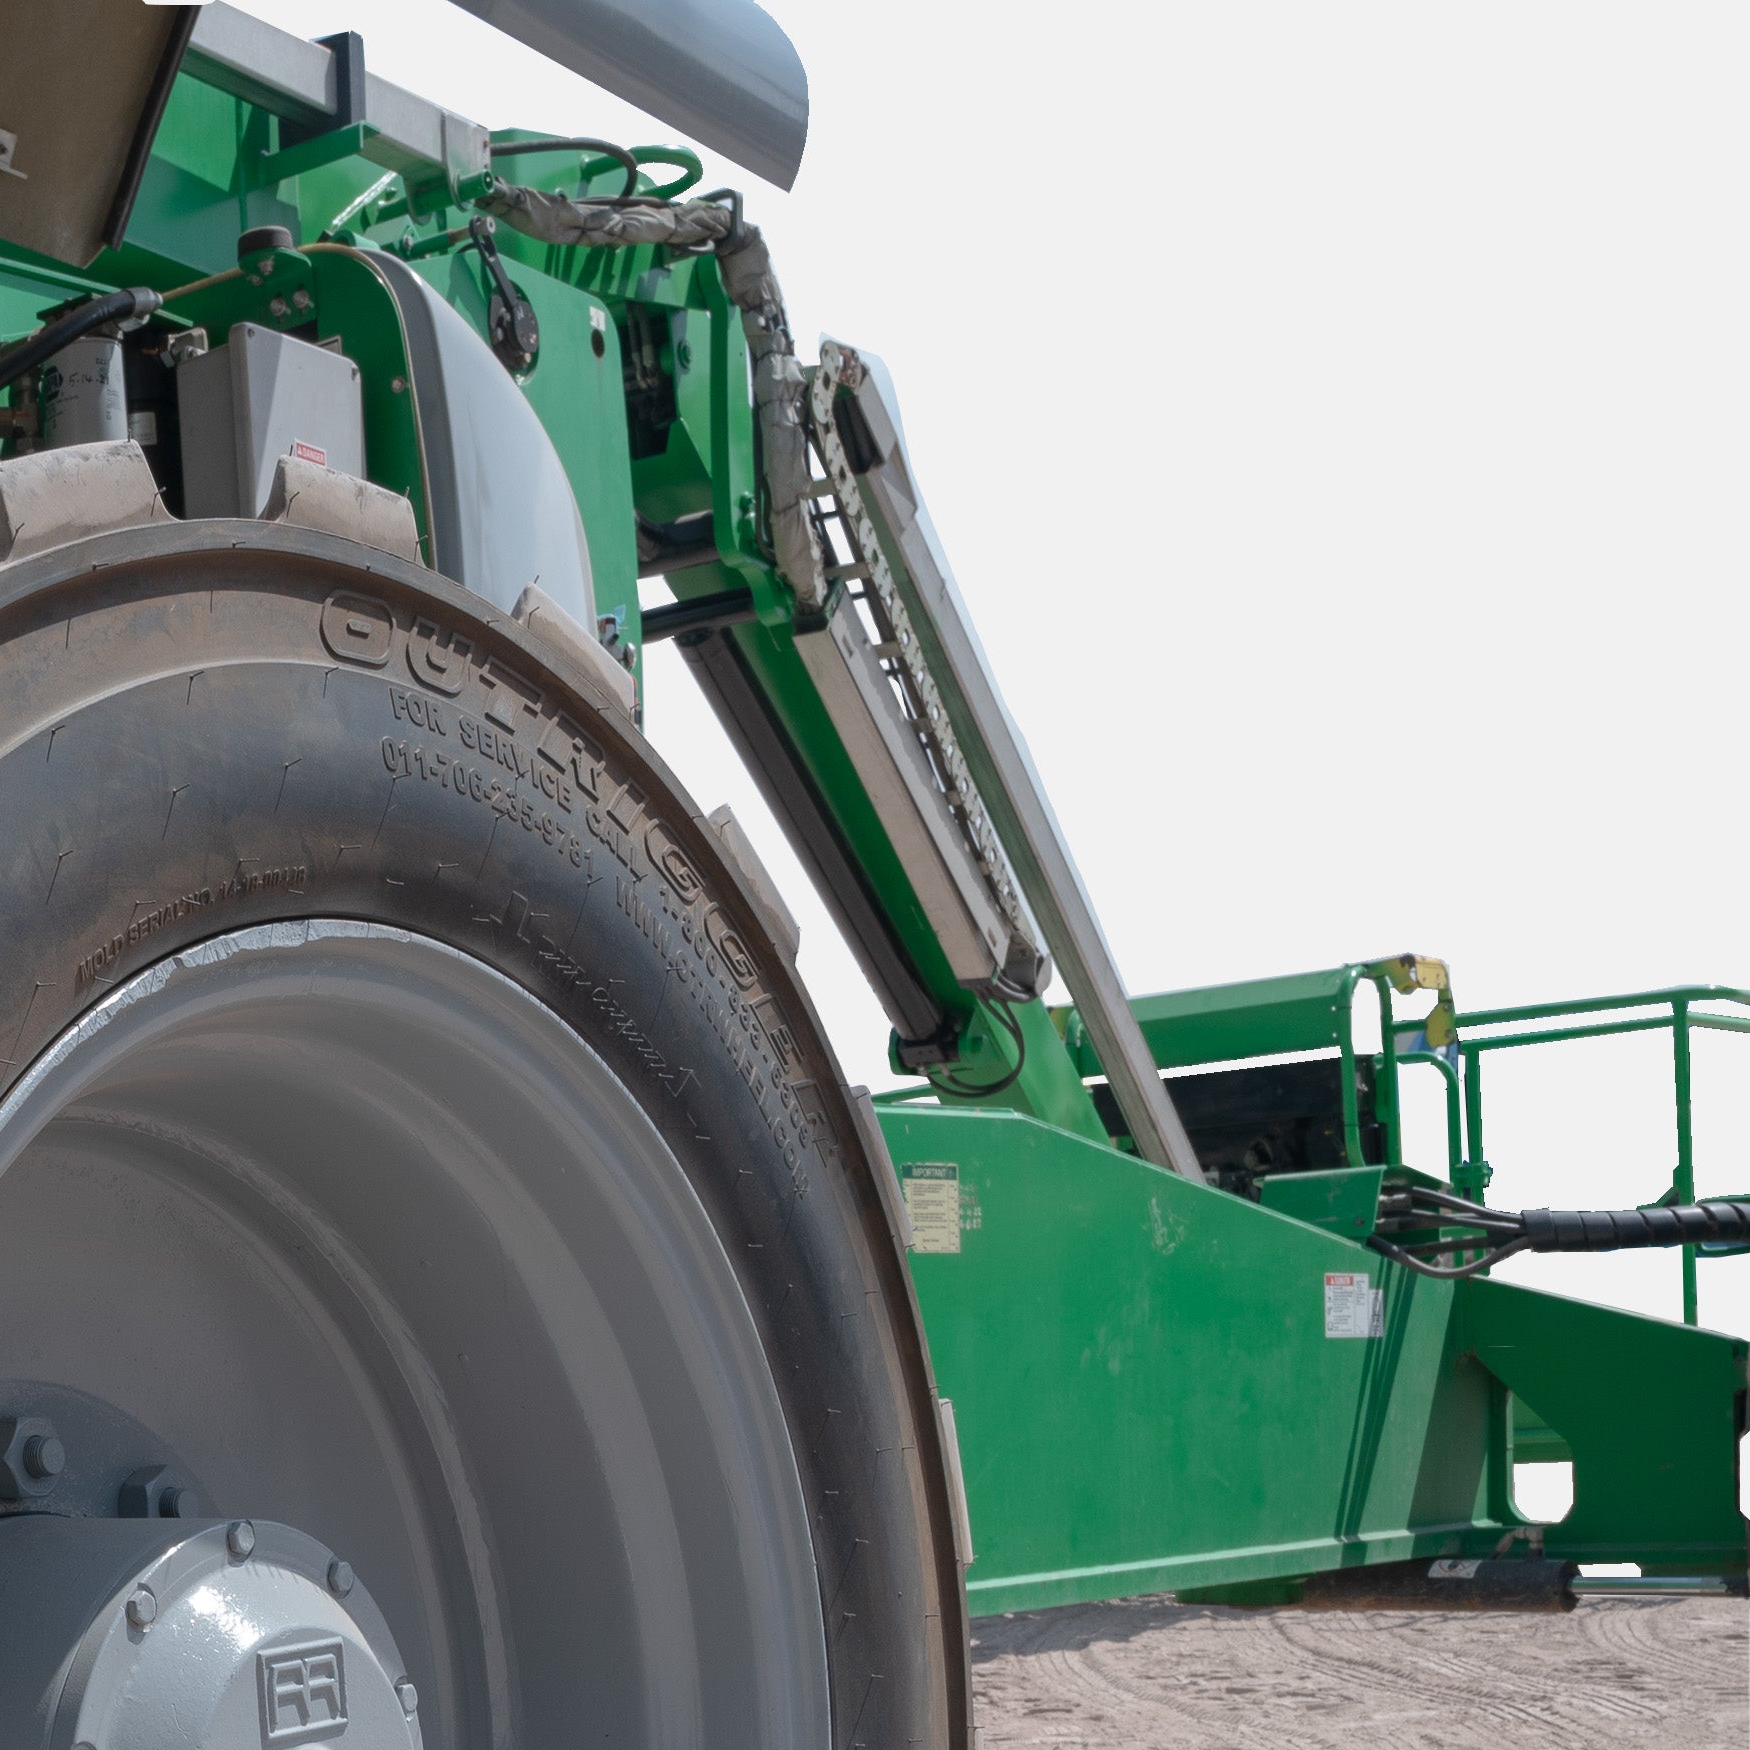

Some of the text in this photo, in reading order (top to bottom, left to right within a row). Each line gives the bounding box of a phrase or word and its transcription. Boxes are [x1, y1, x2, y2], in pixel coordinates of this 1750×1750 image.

[302, 446, 324, 462] DANGER
[380, 734, 596, 869] 011-706-235-9781
[388, 686, 447, 737] FOR
[458, 714, 573, 814] SERVICE
[585, 802, 641, 880] CALL
[319, 588, 847, 1168] OUTRIGGER
[78, 934, 125, 983] MOLD
[128, 900, 185, 944] SERIAL
[912, 1168, 947, 1178] IMPORTANT
